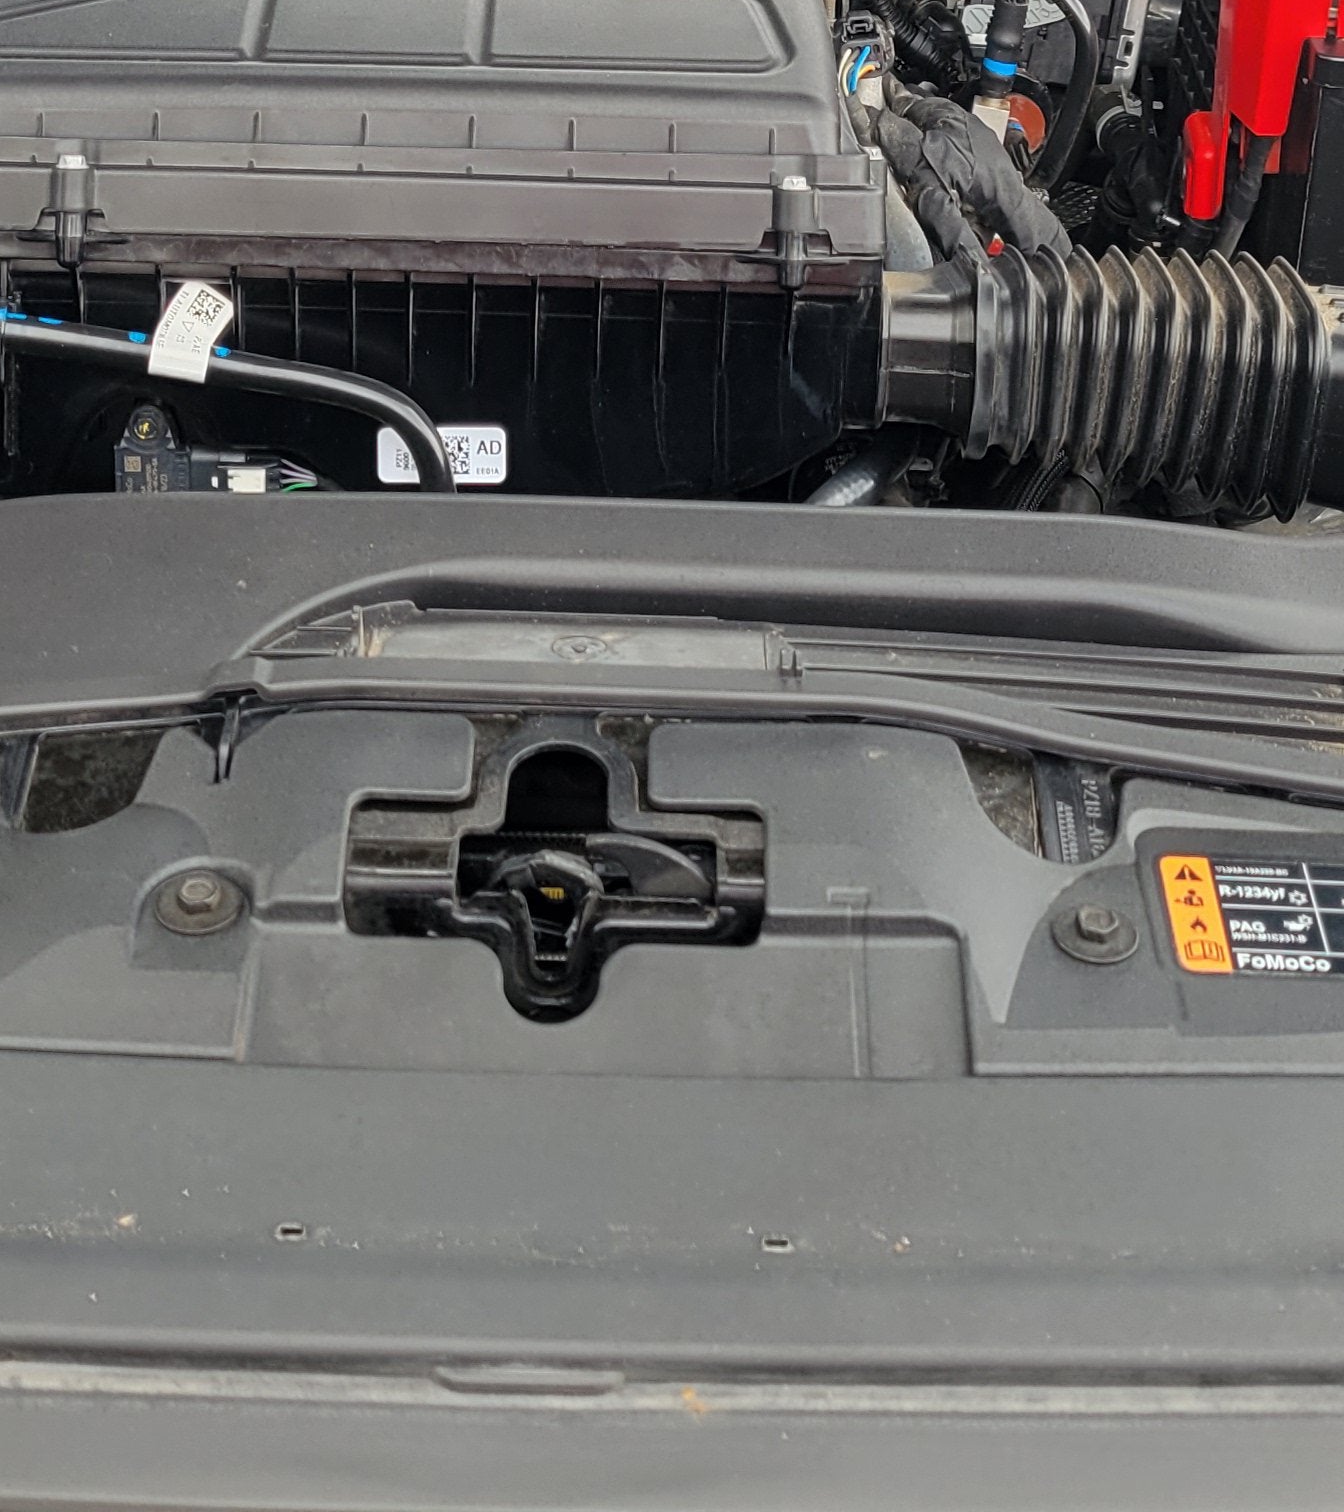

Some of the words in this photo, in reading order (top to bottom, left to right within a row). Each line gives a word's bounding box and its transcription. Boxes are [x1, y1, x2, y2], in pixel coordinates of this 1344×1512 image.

[476, 440, 502, 455] AD
[1218, 884, 1285, 902] R-1234yf
[1230, 919, 1266, 933] PAG
[1237, 953, 1331, 972] FoMoCo
